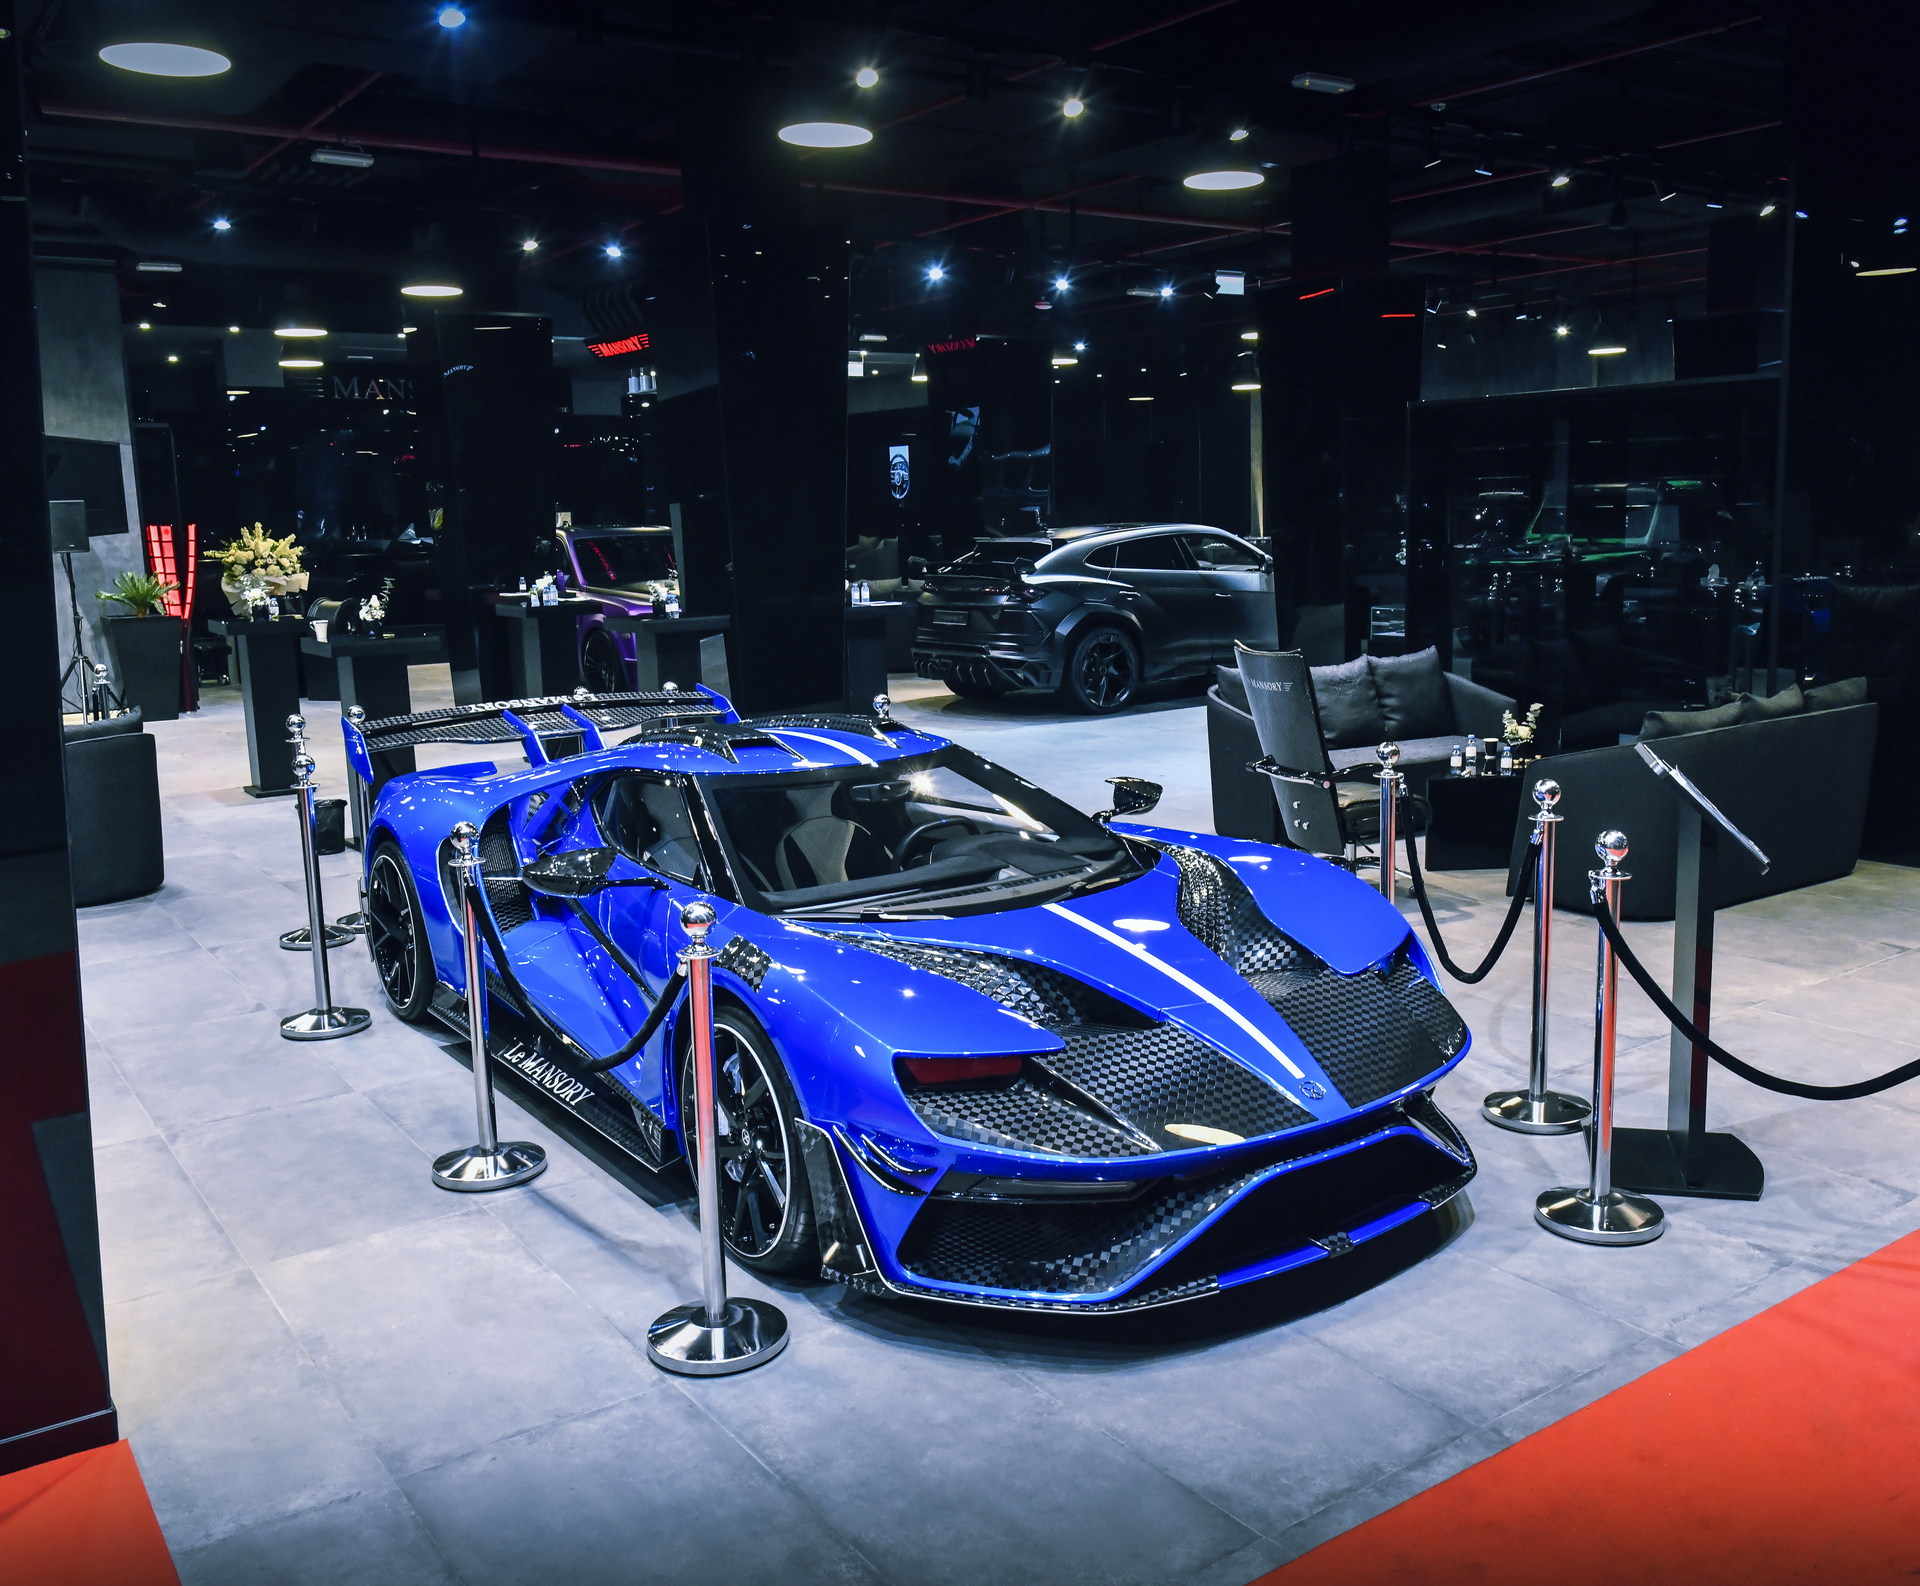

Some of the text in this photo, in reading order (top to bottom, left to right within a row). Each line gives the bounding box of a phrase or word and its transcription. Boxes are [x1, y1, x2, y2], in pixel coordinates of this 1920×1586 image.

[598, 335, 643, 357] MANSORY
[1250, 678, 1282, 692] MANSORY
[469, 695, 571, 713] MANSORY
[503, 1041, 596, 1107] Le MANSORY
